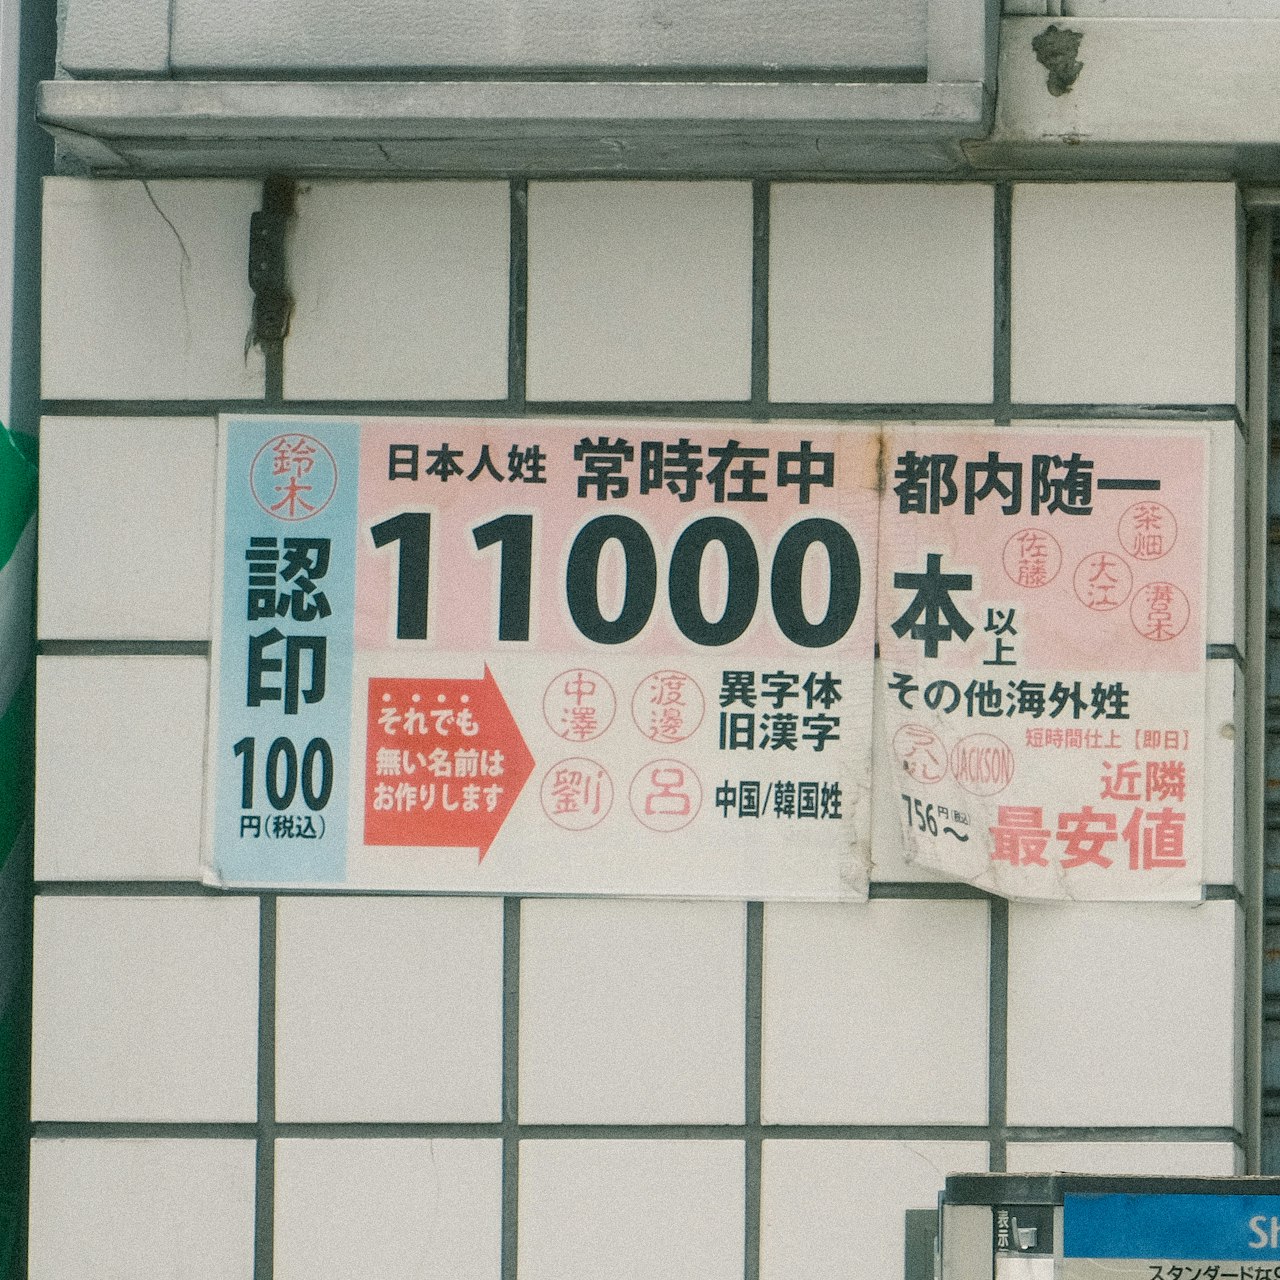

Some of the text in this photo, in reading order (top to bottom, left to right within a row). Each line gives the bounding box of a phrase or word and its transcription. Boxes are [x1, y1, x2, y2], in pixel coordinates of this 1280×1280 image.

[271, 437, 317, 517] 鈴木
[389, 443, 548, 485] 日本人姓
[573, 436, 835, 504] 常時在中
[893, 450, 1162, 516] 都内随一
[370, 511, 861, 649] 11000
[1017, 532, 1047, 586] 佐藤
[1088, 555, 1119, 609] 大江
[245, 536, 333, 716] 認印
[890, 553, 975, 659] 本
[983, 607, 1018, 666] 以上
[561, 672, 597, 739] 中澤
[719, 671, 843, 709] 異字体
[887, 671, 1130, 721] その他海外姓
[377, 708, 480, 737] それでも
[719, 711, 841, 752] 旧漢字
[233, 736, 334, 812] 100
[376, 747, 505, 778] 無い名前は
[954, 747, 1012, 784] JACKSON
[1099, 760, 1187, 802] 近隣
[373, 782, 504, 813] お作りします
[551, 768, 602, 815] 劉
[644, 768, 691, 816] 呂
[715, 779, 843, 819] 中国/韓国姓
[239, 814, 326, 841] 円(税込)
[988, 805, 1187, 871] 最安値
